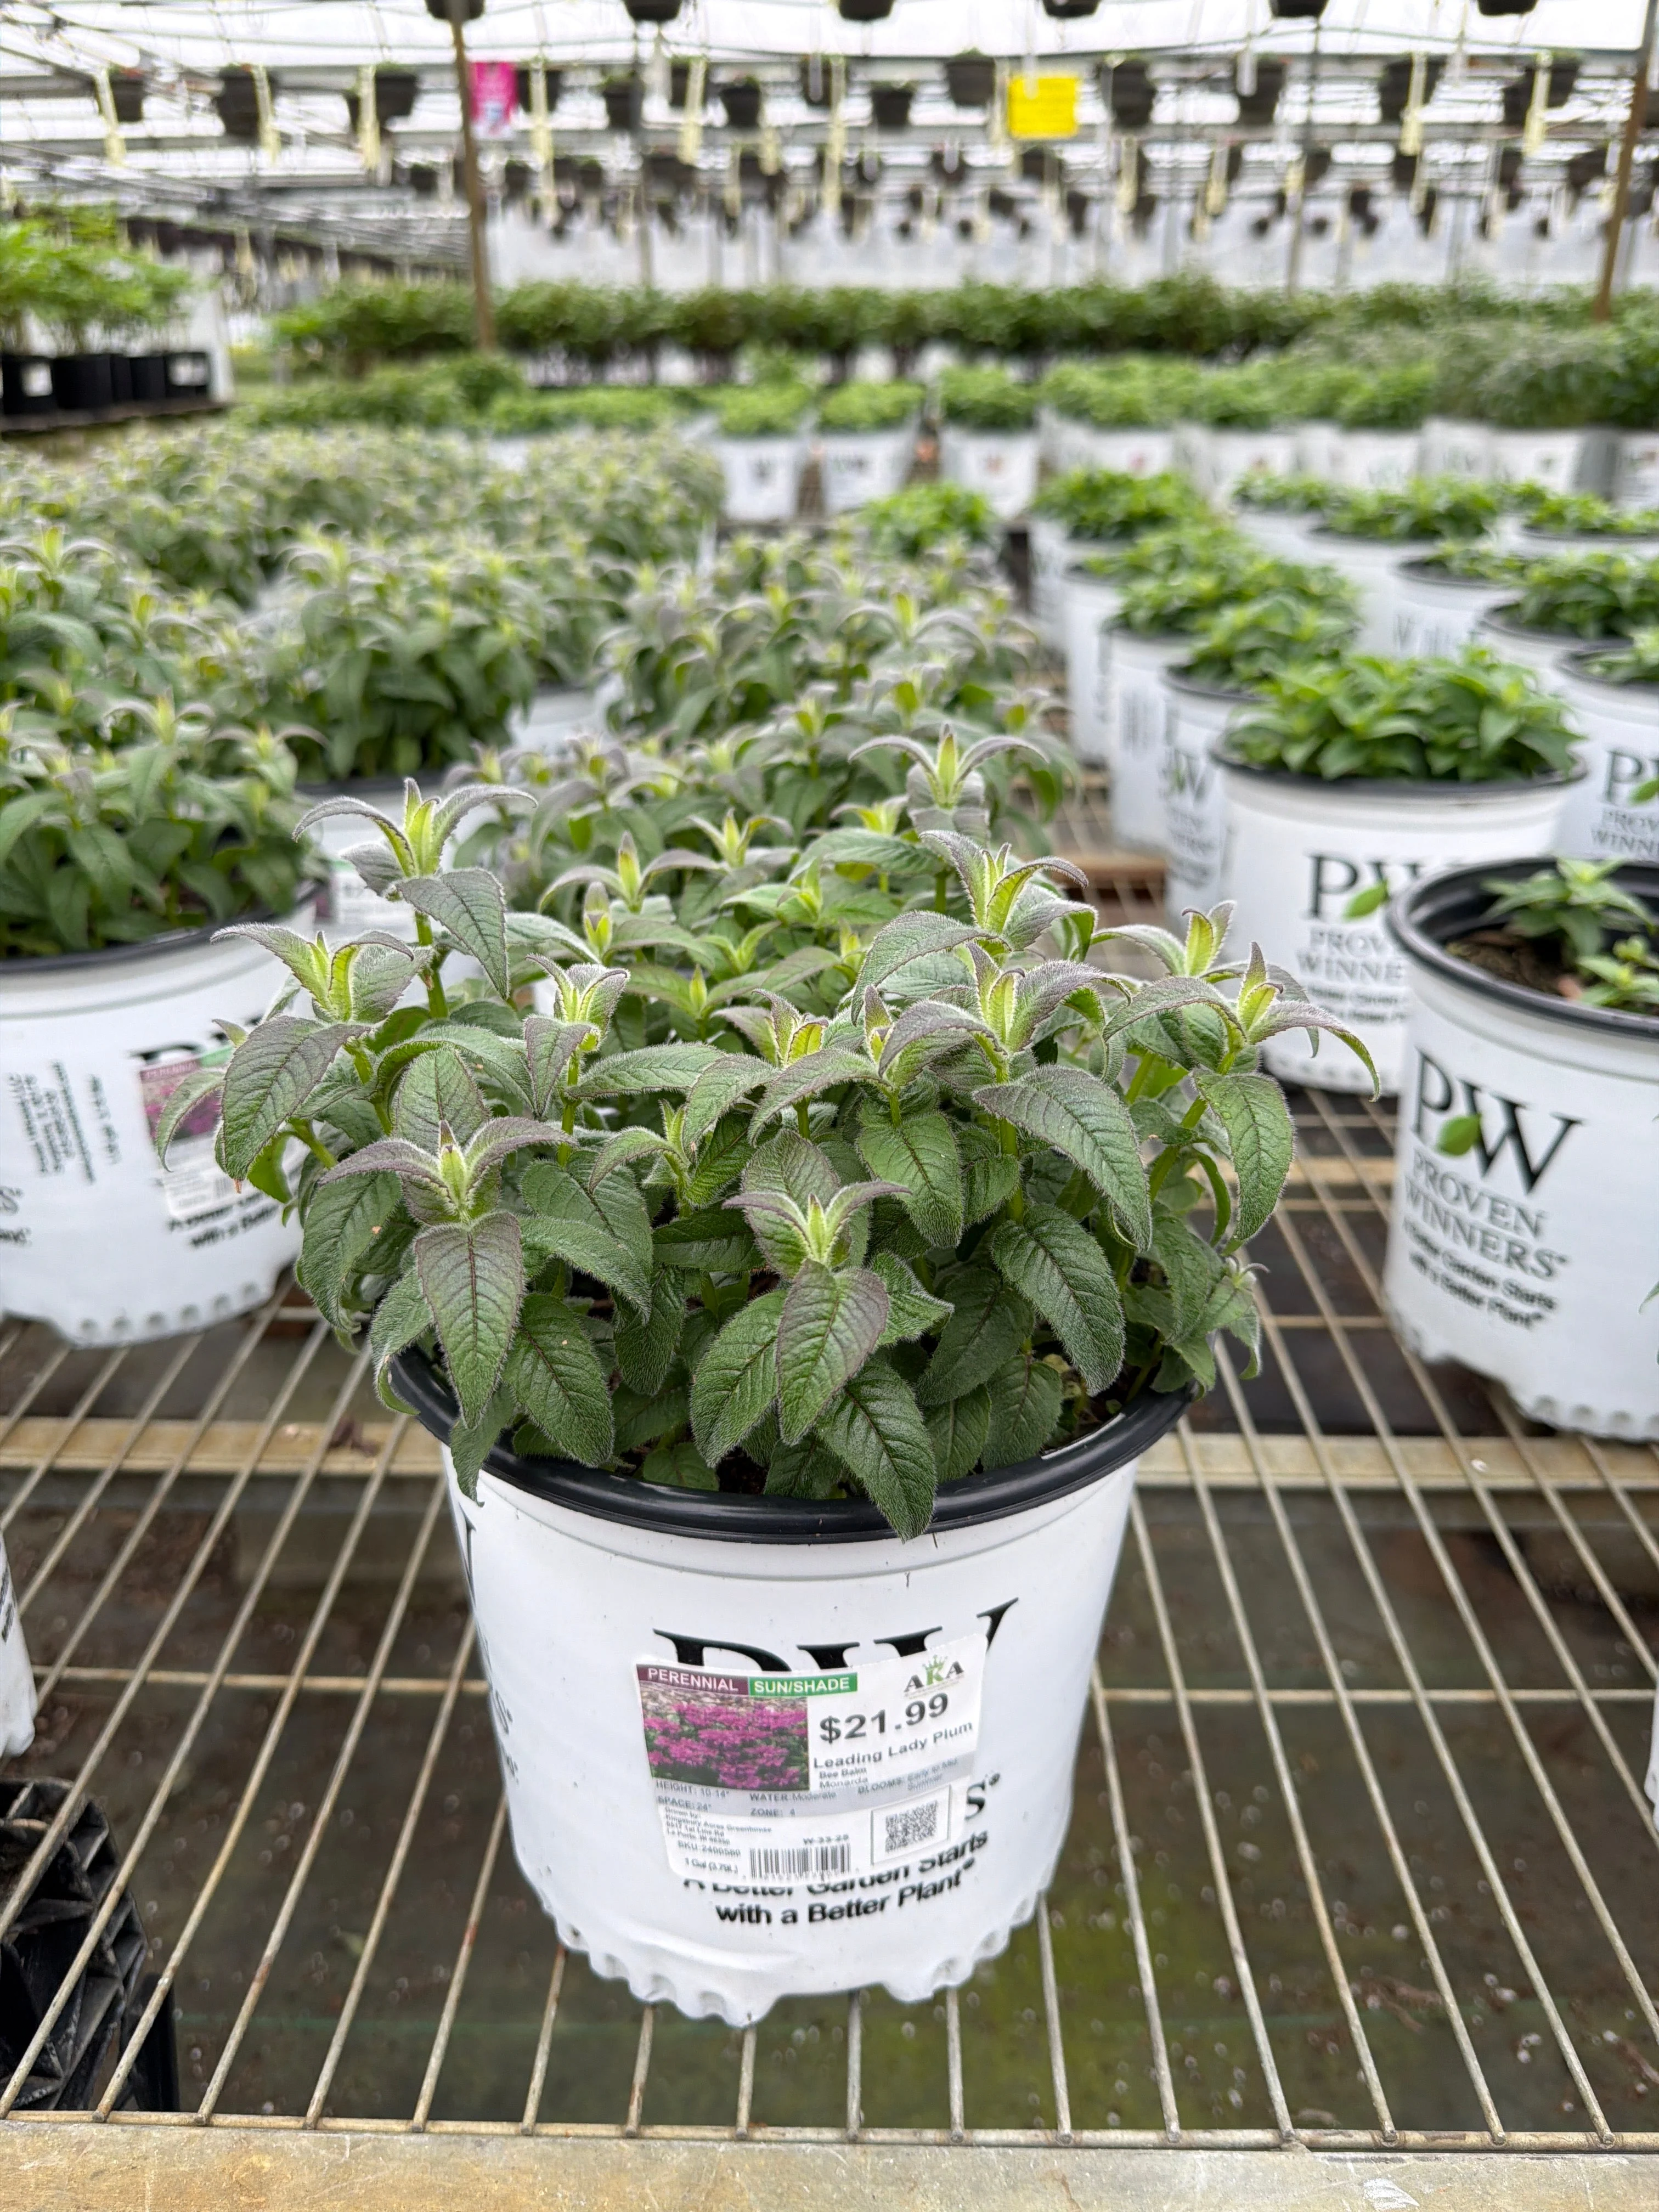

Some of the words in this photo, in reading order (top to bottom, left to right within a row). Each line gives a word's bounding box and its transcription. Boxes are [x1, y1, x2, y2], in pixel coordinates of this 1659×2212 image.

[648, 1668, 739, 1692] PERENNIAL
[754, 1677, 850, 1694] SUN/SHADE
[819, 1692, 949, 1744] $21.99
[814, 1751, 882, 1768] Leading
[888, 1737, 927, 1757] Lady
[933, 1722, 973, 1743] Plum
[819, 1771, 839, 1779] Bee
[841, 1767, 867, 1776] Balm
[820, 1777, 868, 1789] Monarda
[792, 1791, 837, 1802] Moderate
[917, 1830, 989, 1873] Starts
[715, 1901, 772, 1925] with
[781, 1908, 799, 1925] a
[808, 1894, 891, 1923] Better
